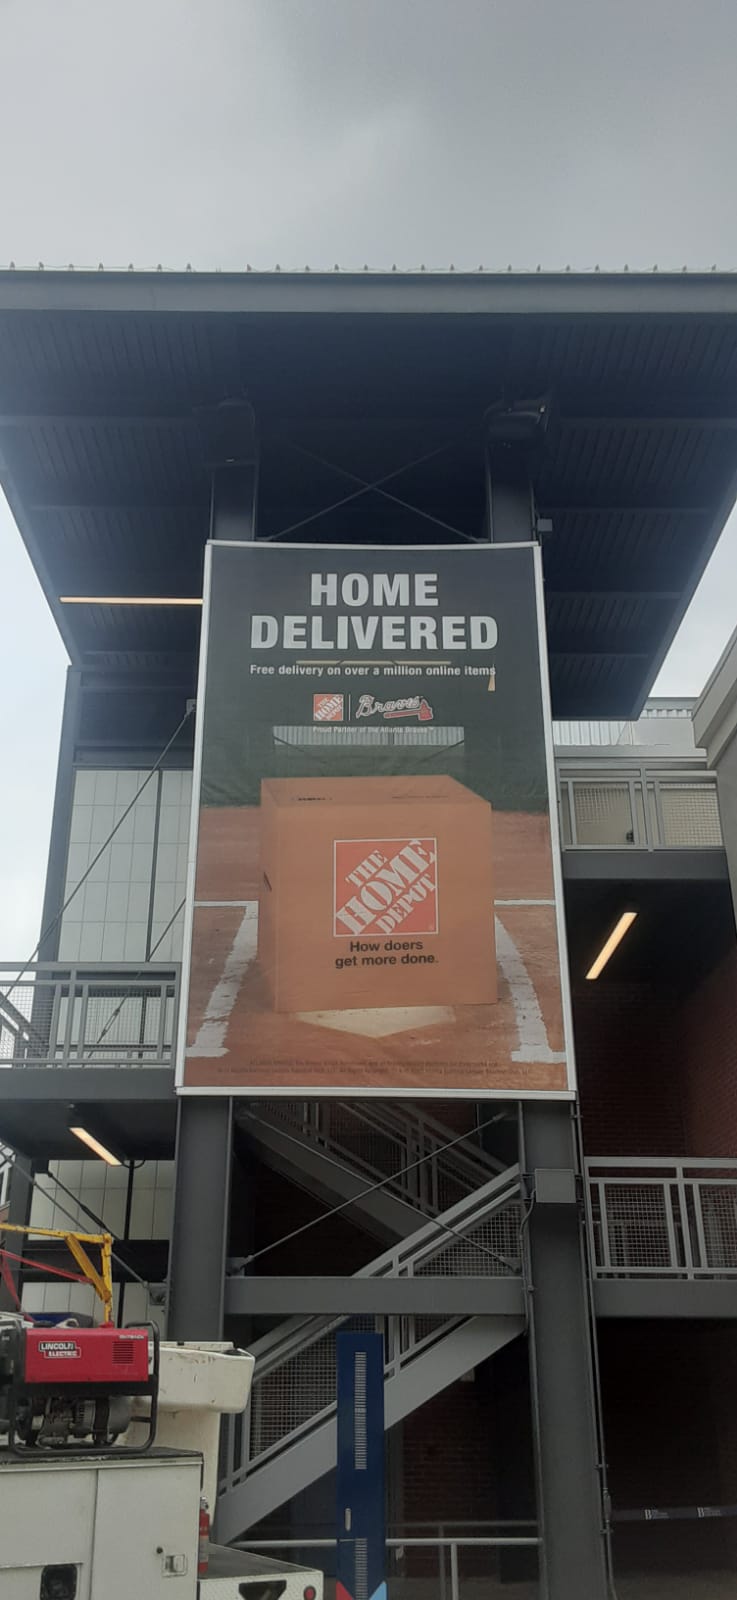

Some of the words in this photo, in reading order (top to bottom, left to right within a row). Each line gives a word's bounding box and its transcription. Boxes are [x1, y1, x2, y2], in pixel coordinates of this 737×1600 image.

[311, 573, 439, 607] HOME
[251, 616, 498, 650] DELIVERED
[250, 664, 275, 675] Free
[278, 664, 324, 678] delivery
[327, 667, 341, 676] on
[344, 667, 369, 676] over
[373, 667, 380, 676] a
[383, 664, 423, 676] million
[426, 665, 461, 676] online
[464, 665, 496, 677] items
[315, 694, 343, 720] HOME
[355, 694, 420, 719] Braves
[345, 849, 389, 888] THE
[336, 839, 436, 935] HOME
[375, 873, 436, 935] DEPOT
[350, 941, 380, 952] How
[384, 940, 423, 951] doers
[335, 955, 358, 969] get
[362, 955, 397, 965] more
[401, 954, 439, 965] done.
[41, 1342, 74, 1350] LINCOLN
